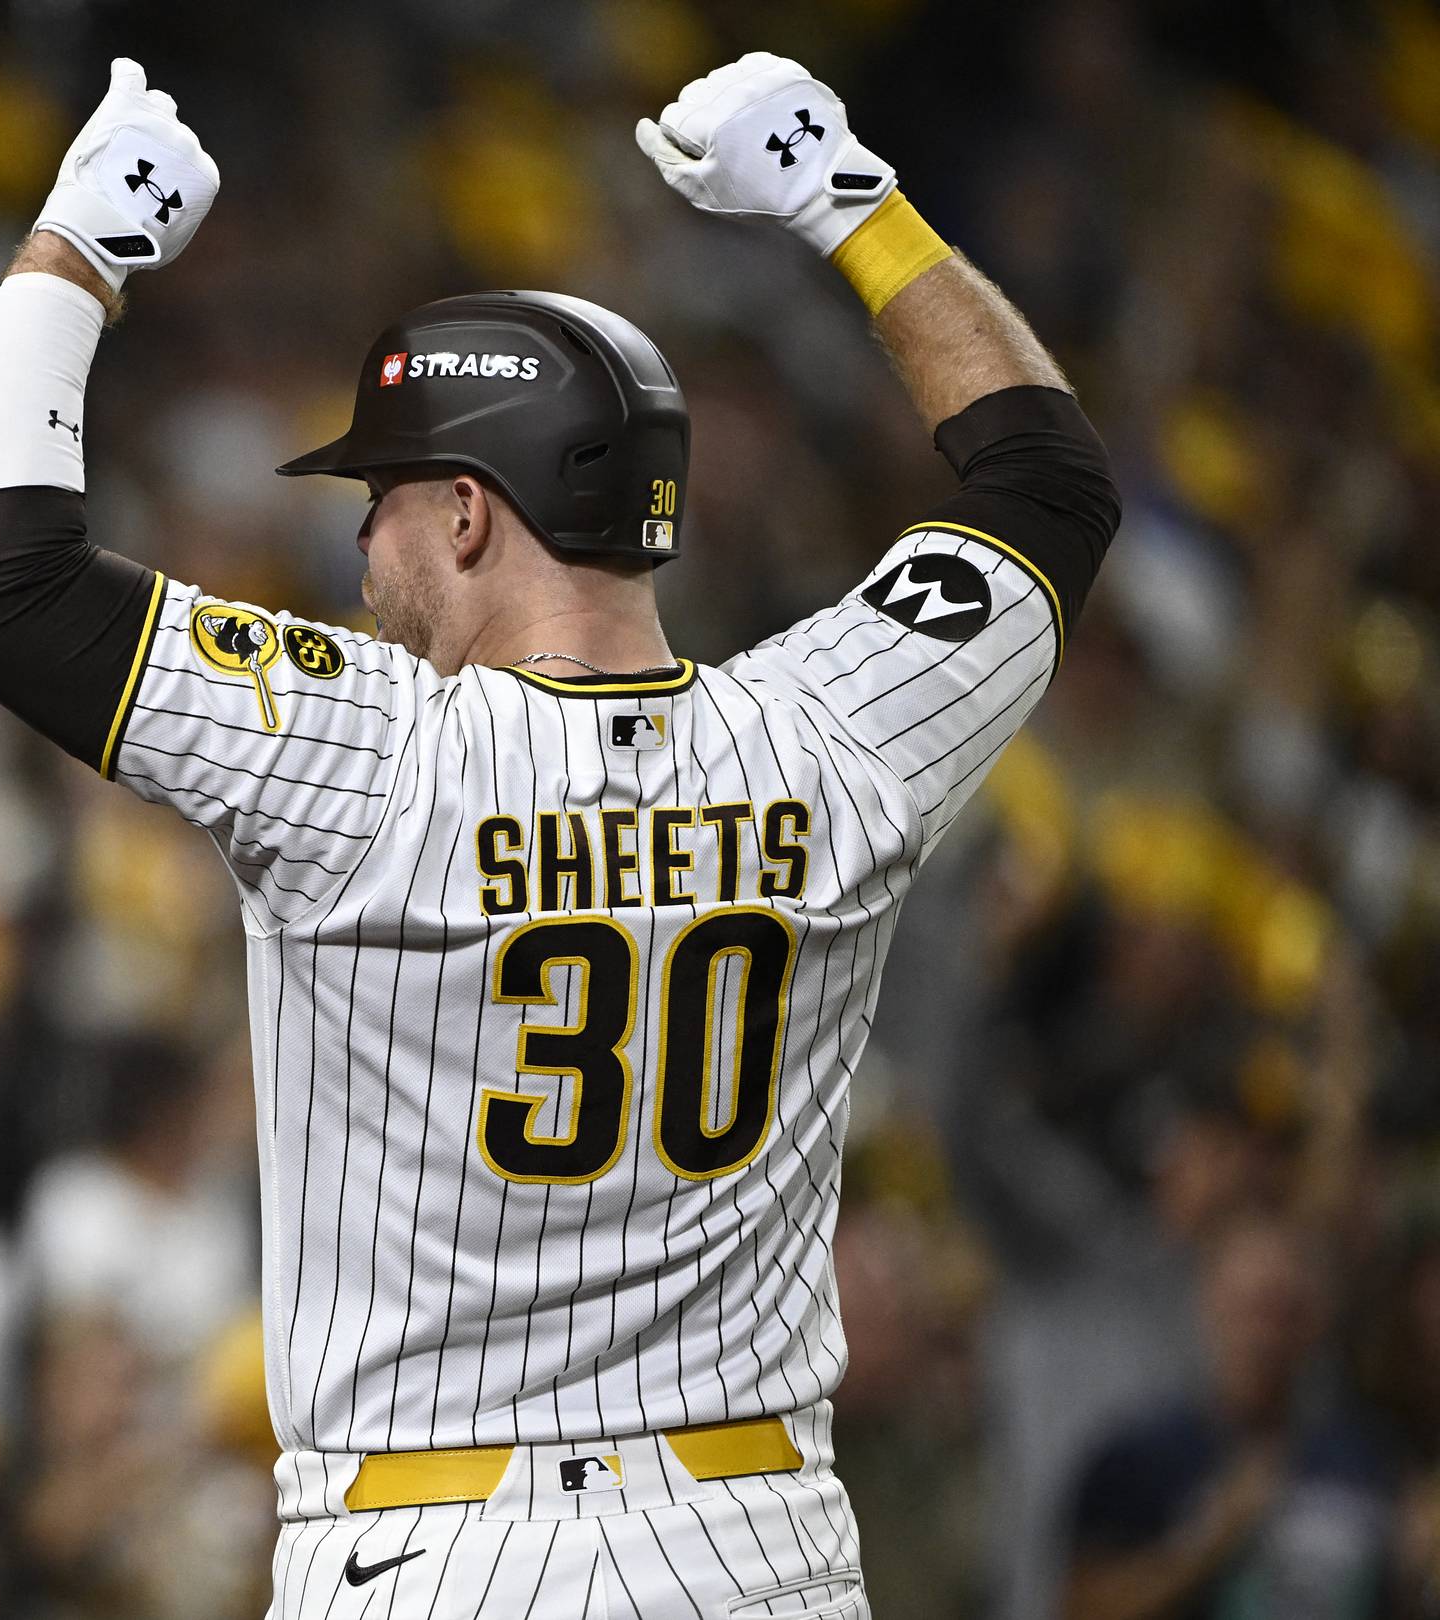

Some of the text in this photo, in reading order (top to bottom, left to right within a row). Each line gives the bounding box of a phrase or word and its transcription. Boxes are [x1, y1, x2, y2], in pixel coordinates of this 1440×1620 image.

[408, 353, 540, 381] STRAUSS
[651, 479, 676, 516] 30
[293, 630, 333, 672] 35
[475, 799, 812, 916] SHEETS
[476, 906, 797, 1185] 30
